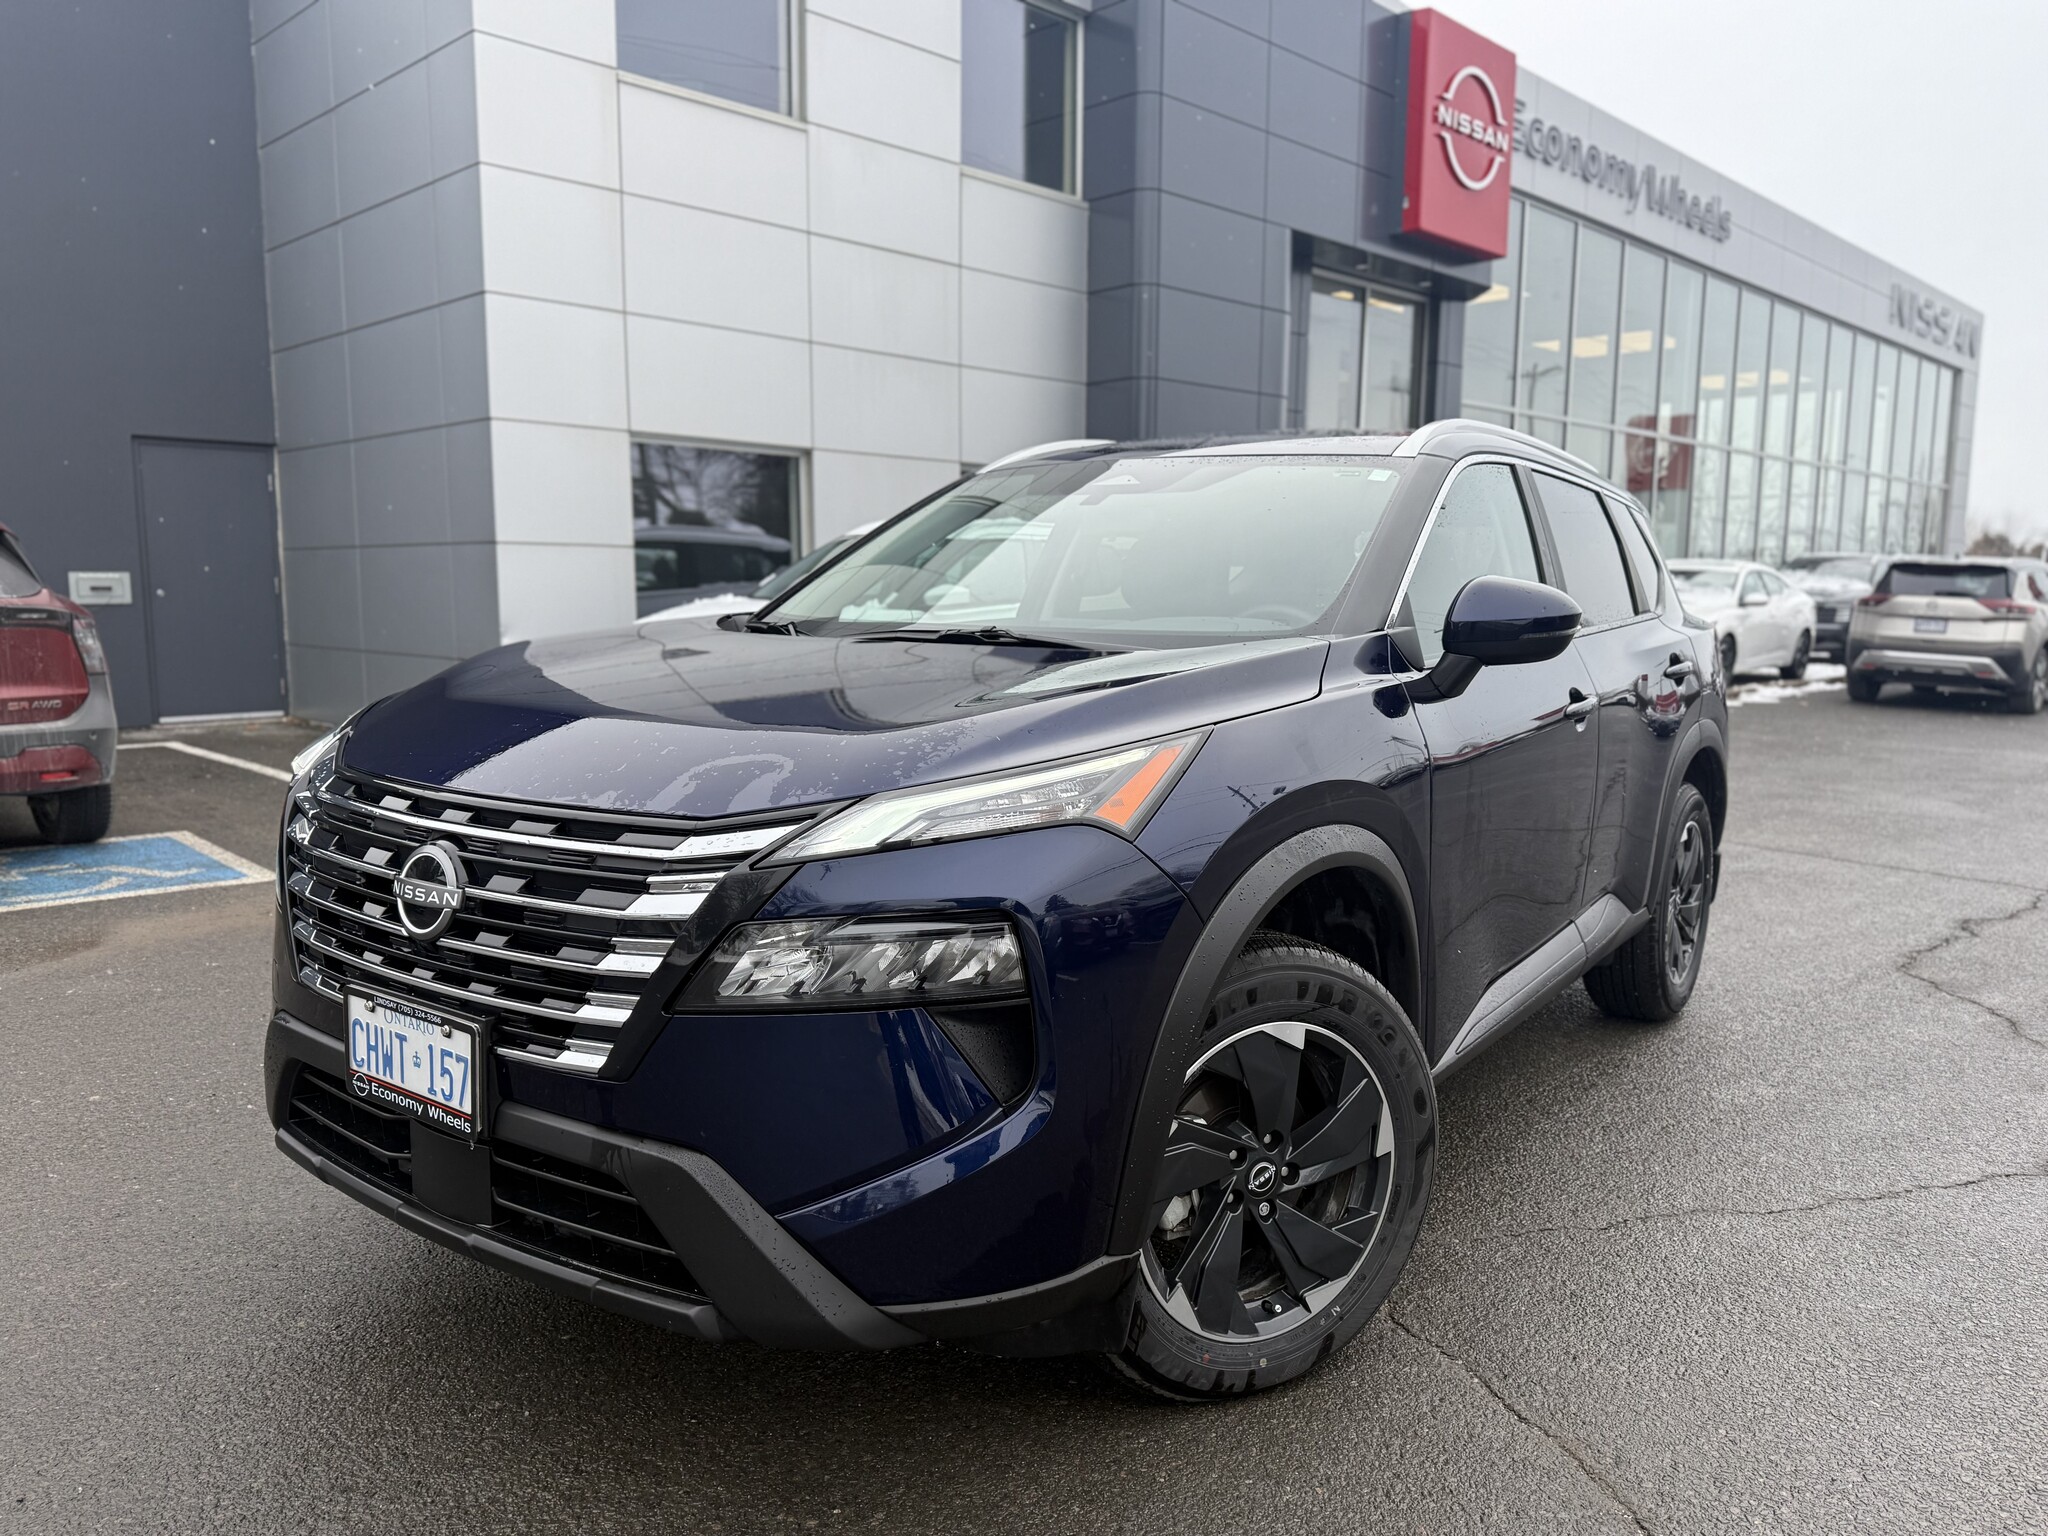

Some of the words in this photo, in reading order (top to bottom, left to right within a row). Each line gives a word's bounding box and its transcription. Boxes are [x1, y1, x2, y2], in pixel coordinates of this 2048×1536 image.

[1436, 104, 1510, 152] NISSAN
[1889, 283, 1978, 359] NISSAN
[31, 699, 62, 709] AWD
[393, 881, 459, 907] NISSAN
[373, 996, 398, 1009] LINDSAY
[398, 1002, 414, 1015] (705)
[414, 1009, 442, 1024] 324-5566
[384, 1008, 434, 1036] ONTARIO
[351, 1018, 408, 1084] CHWT
[427, 1043, 469, 1108] 157
[352, 1079, 370, 1091] NISSAN
[371, 1082, 424, 1116] Economy
[428, 1104, 472, 1133] Wheels
[1248, 1164, 1276, 1190] NISSAN
